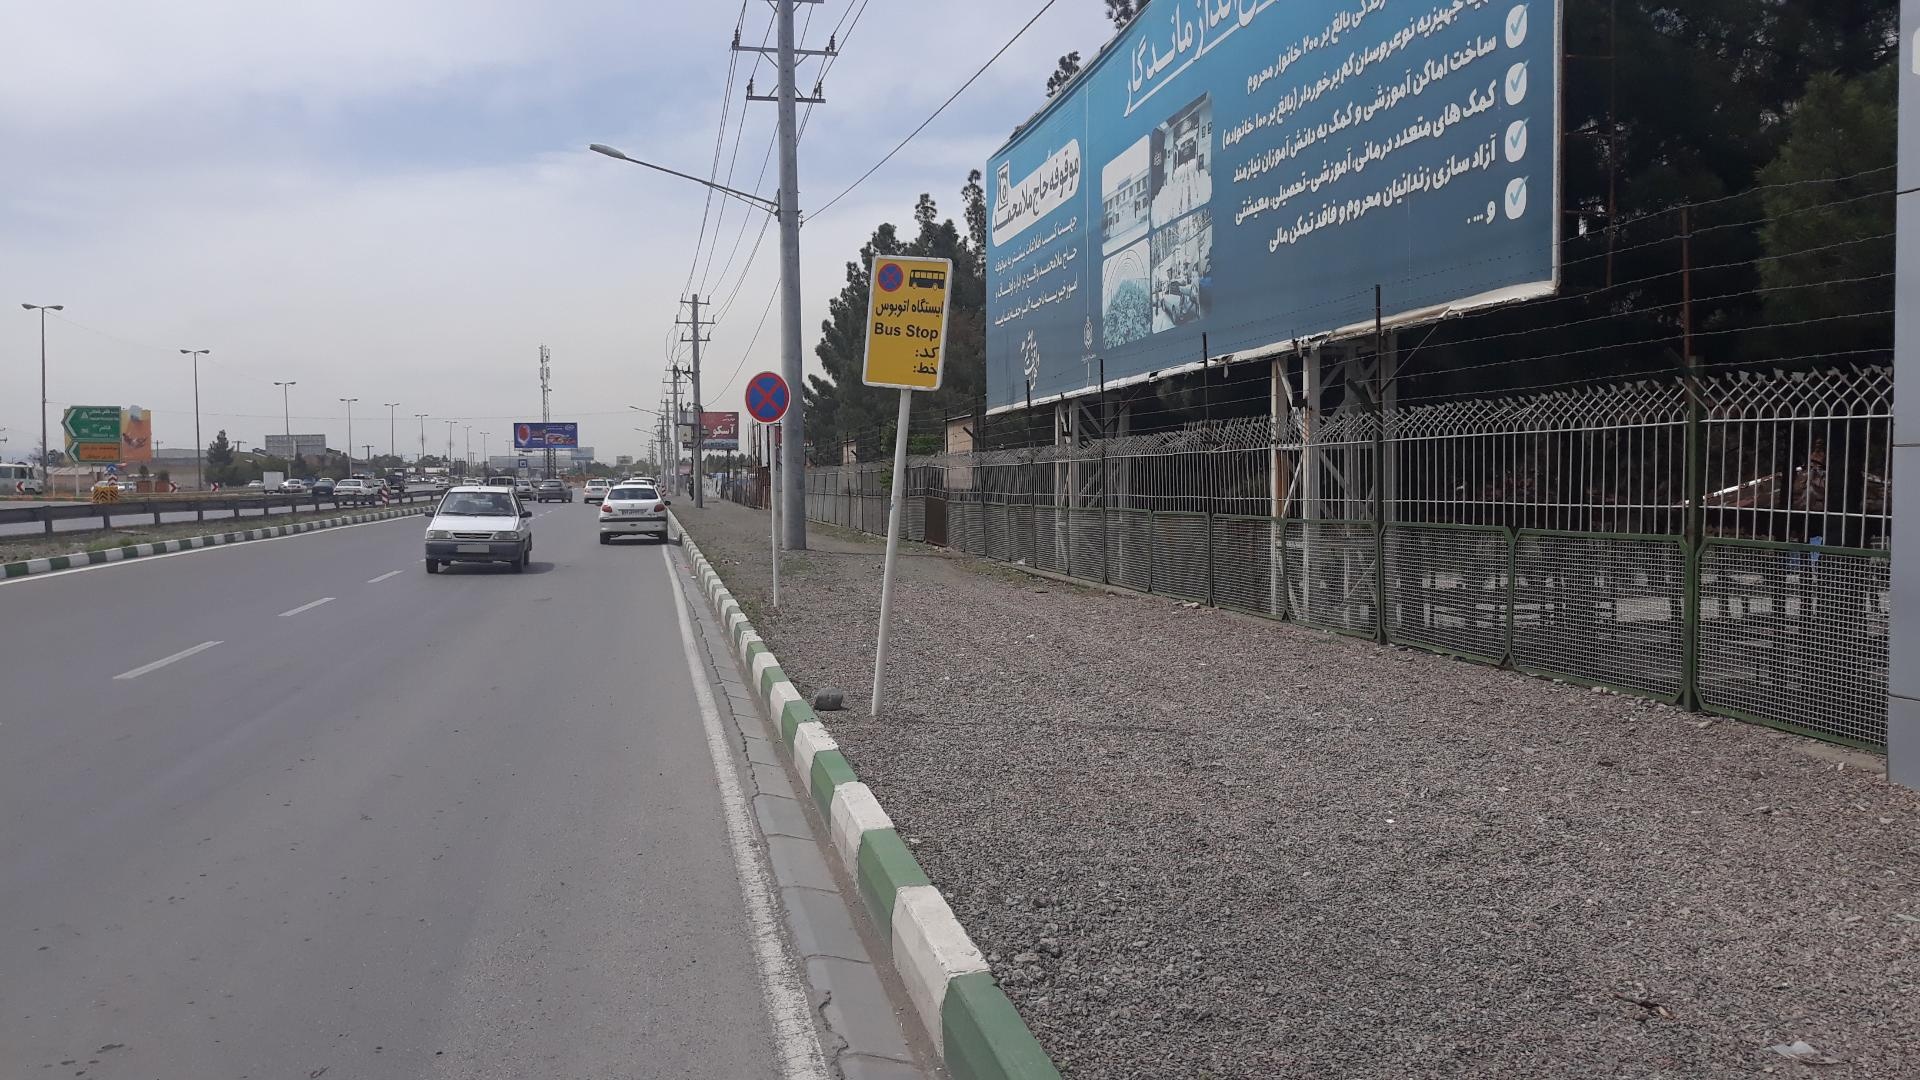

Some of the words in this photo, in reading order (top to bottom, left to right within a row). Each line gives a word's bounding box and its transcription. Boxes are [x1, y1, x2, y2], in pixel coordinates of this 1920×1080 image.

[1331, 10, 1351, 45] بالغ
[1416, 0, 1464, 38] جهیزیه
[1303, 35, 1319, 55] ۲۰۰
[1320, 26, 1330, 49] بر
[1355, 16, 1416, 76] نوعروسان
[1449, 34, 1497, 71] ساخت
[1123, 3, 1193, 118] ماندگار
[1274, 41, 1302, 78] خانوار
[1340, 51, 1355, 84] کم
[1412, 53, 1449, 96] اماکن
[1246, 65, 1273, 96] محروم
[1363, 67, 1412, 122] آموزشی
[1276, 86, 1298, 125] (بالغ
[1354, 104, 1362, 126] و
[1462, 79, 1497, 119] کمک
[1255, 112, 1267, 129] ۱۰۰
[1267, 106, 1276, 128] بر
[1316, 122, 1328, 144] به
[1328, 100, 1354, 134] کمک
[1393, 115, 1431, 150] متعدد
[1432, 102, 1461, 138] های
[1221, 117, 1255, 151] خانواده)
[1289, 127, 1317, 159] دانش
[1233, 152, 1262, 183] نیازمند
[1261, 134, 1291, 174] آموزان
[1471, 132, 1497, 170] آزاد
[1049, 149, 1079, 198] موقوفه
[1382, 165, 1431, 208] زندانیان
[1431, 153, 1470, 190] سازی
[1032, 171, 1049, 217] حاج
[1234, 195, 1270, 226] معیشتی
[1345, 191, 1382, 221] محروم
[1289, 211, 1314, 244] تمکن
[1314, 198, 1338, 230] فاقد
[1338, 205, 1346, 226] و
[1486, 200, 1497, 225] و
[1268, 226, 1289, 253] مالی
[875, 299, 910, 318] اتوبوس
[911, 298, 944, 318] ایستگاه
[874, 322, 901, 337] Bus
[905, 324, 939, 342] Stop
[912, 362, 938, 376] خط:
[915, 346, 940, 359] کد:
